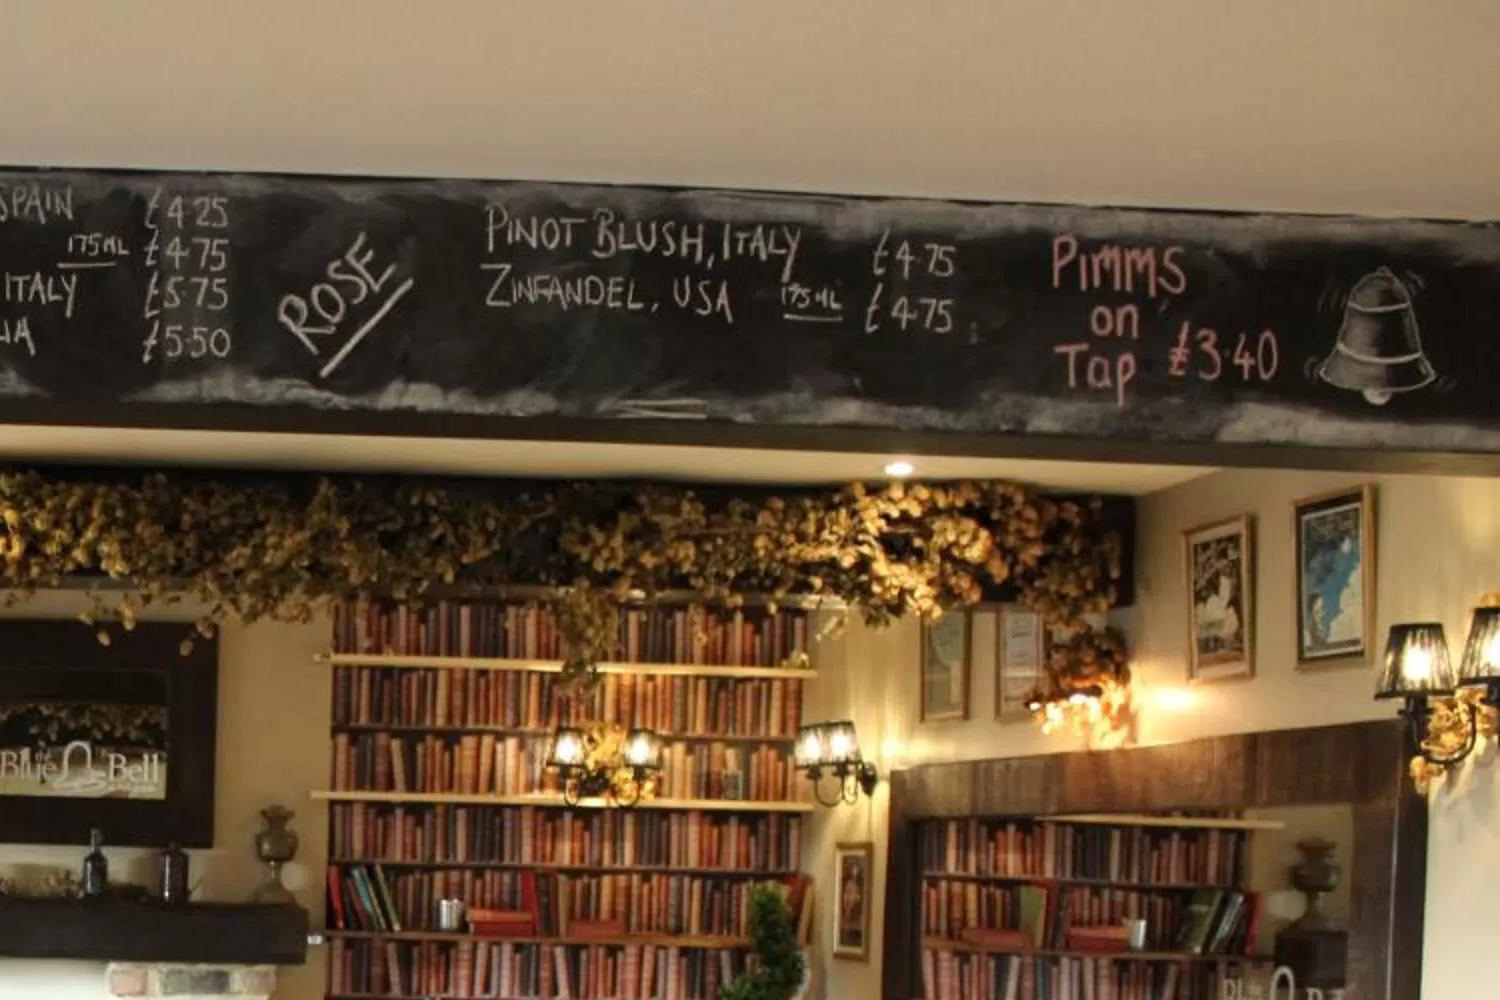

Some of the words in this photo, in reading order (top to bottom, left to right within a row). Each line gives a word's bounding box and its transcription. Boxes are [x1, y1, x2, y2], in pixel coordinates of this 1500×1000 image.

[485, 204, 586, 253] PINOT
[722, 223, 800, 283] ITALY
[5, 272, 77, 319] ITALY
[278, 231, 396, 355] ROSE
[672, 275, 734, 324] USA
[1090, 303, 1139, 340] on
[1053, 342, 1137, 408] Tap
[107, 752, 160, 783] Bell
